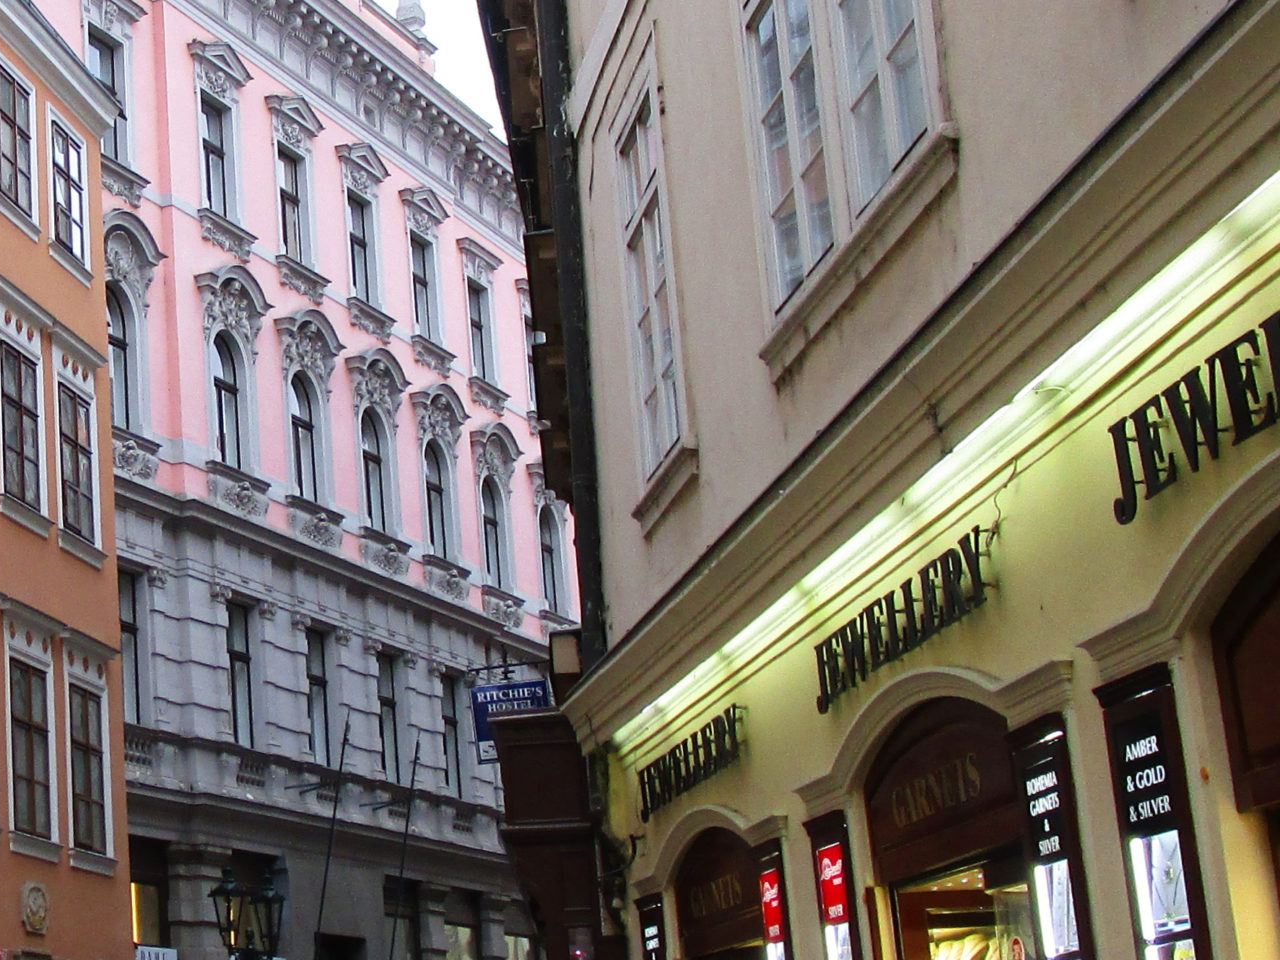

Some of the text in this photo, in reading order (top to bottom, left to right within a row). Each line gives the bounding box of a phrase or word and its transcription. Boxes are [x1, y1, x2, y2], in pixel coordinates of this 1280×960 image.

[814, 525, 987, 715] JEWELLERY
[477, 687, 543, 702] RITCHIE'S
[488, 700, 535, 713] HOSTEL
[1125, 735, 1159, 762] AMBER
[637, 703, 739, 822] JEWELLERY
[892, 752, 981, 828] GARNETS
[1026, 771, 1058, 796] BOHEMIA
[1126, 765, 1166, 792] & GOLD
[1030, 792, 1060, 817] GARNETS
[1129, 795, 1171, 822] & SILVER
[1039, 836, 1061, 856] SILVER
